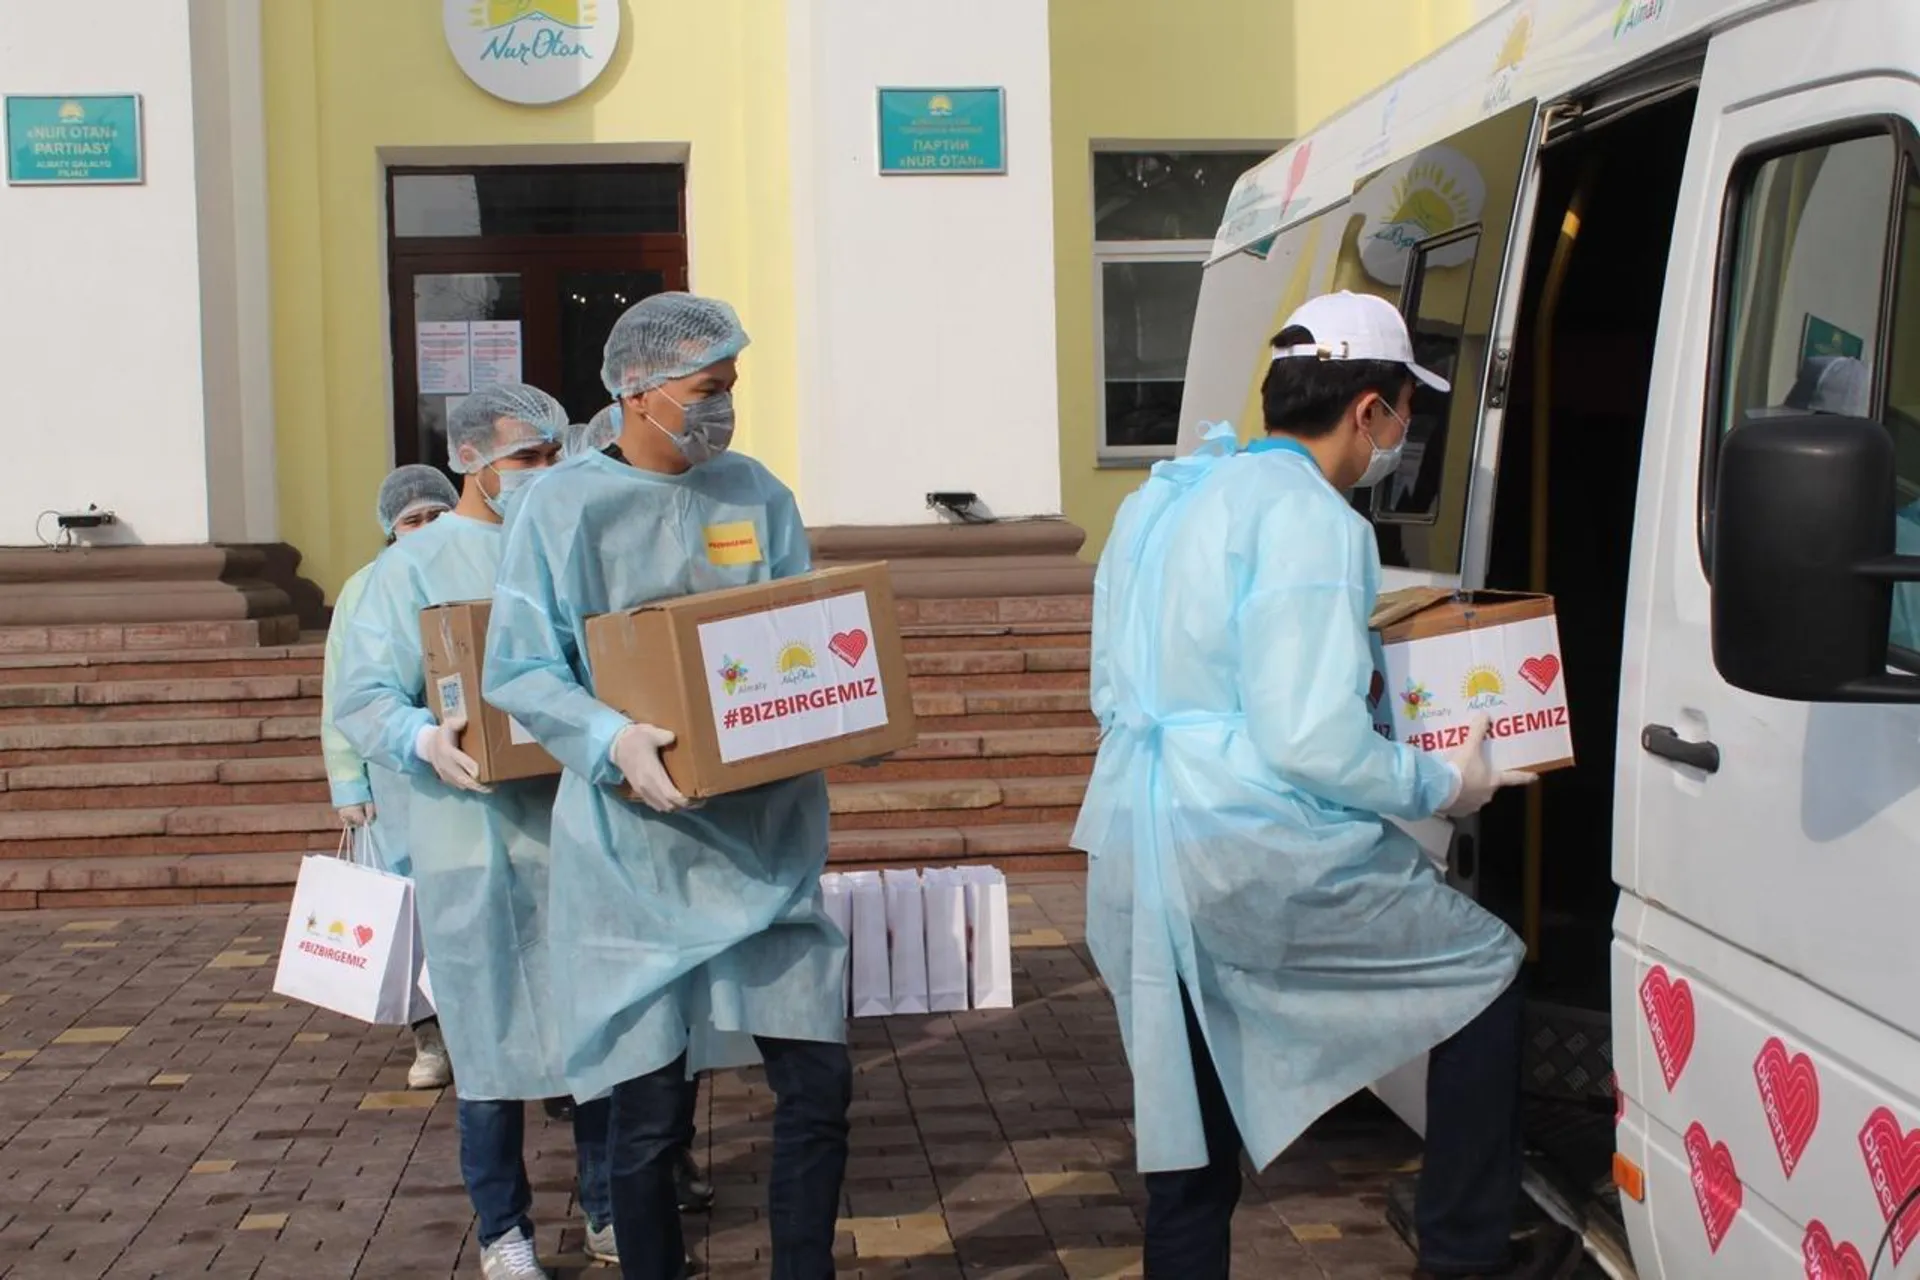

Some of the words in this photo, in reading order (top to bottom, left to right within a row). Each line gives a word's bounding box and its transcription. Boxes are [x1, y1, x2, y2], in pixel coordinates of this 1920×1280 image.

[480, 25, 530, 65] Nur
[532, 28, 593, 59] Otan
[723, 677, 878, 730] #BIZBIRGEMIZ
[298, 940, 368, 970] #BIZBIRGEMIZ
